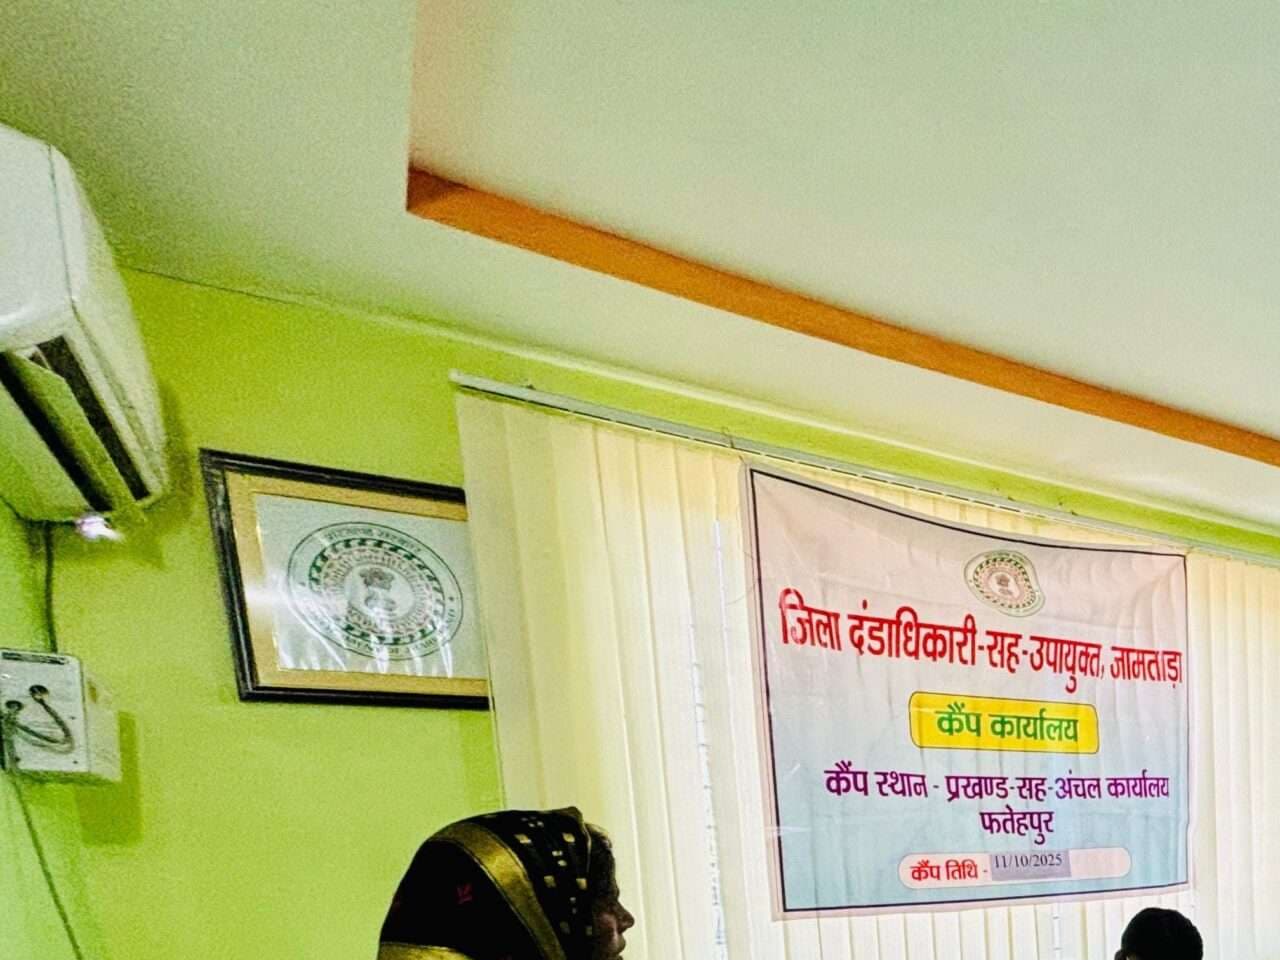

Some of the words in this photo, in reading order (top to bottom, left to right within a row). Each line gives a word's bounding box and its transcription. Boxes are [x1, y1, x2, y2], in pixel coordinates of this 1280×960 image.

[779, 588, 842, 651] जिला
[1110, 645, 1183, 689] जामताड़ा
[935, 701, 982, 737] कैंप
[988, 708, 1079, 742] कार्यालय
[824, 760, 869, 796] कैंप
[874, 770, 928, 798] स्थान
[1105, 769, 1170, 798] कार्यालय
[979, 805, 1055, 846] फतेहपुर
[910, 859, 941, 881] कैंप
[945, 859, 979, 881] तिथि
[994, 853, 1063, 869] 11/10/2025
